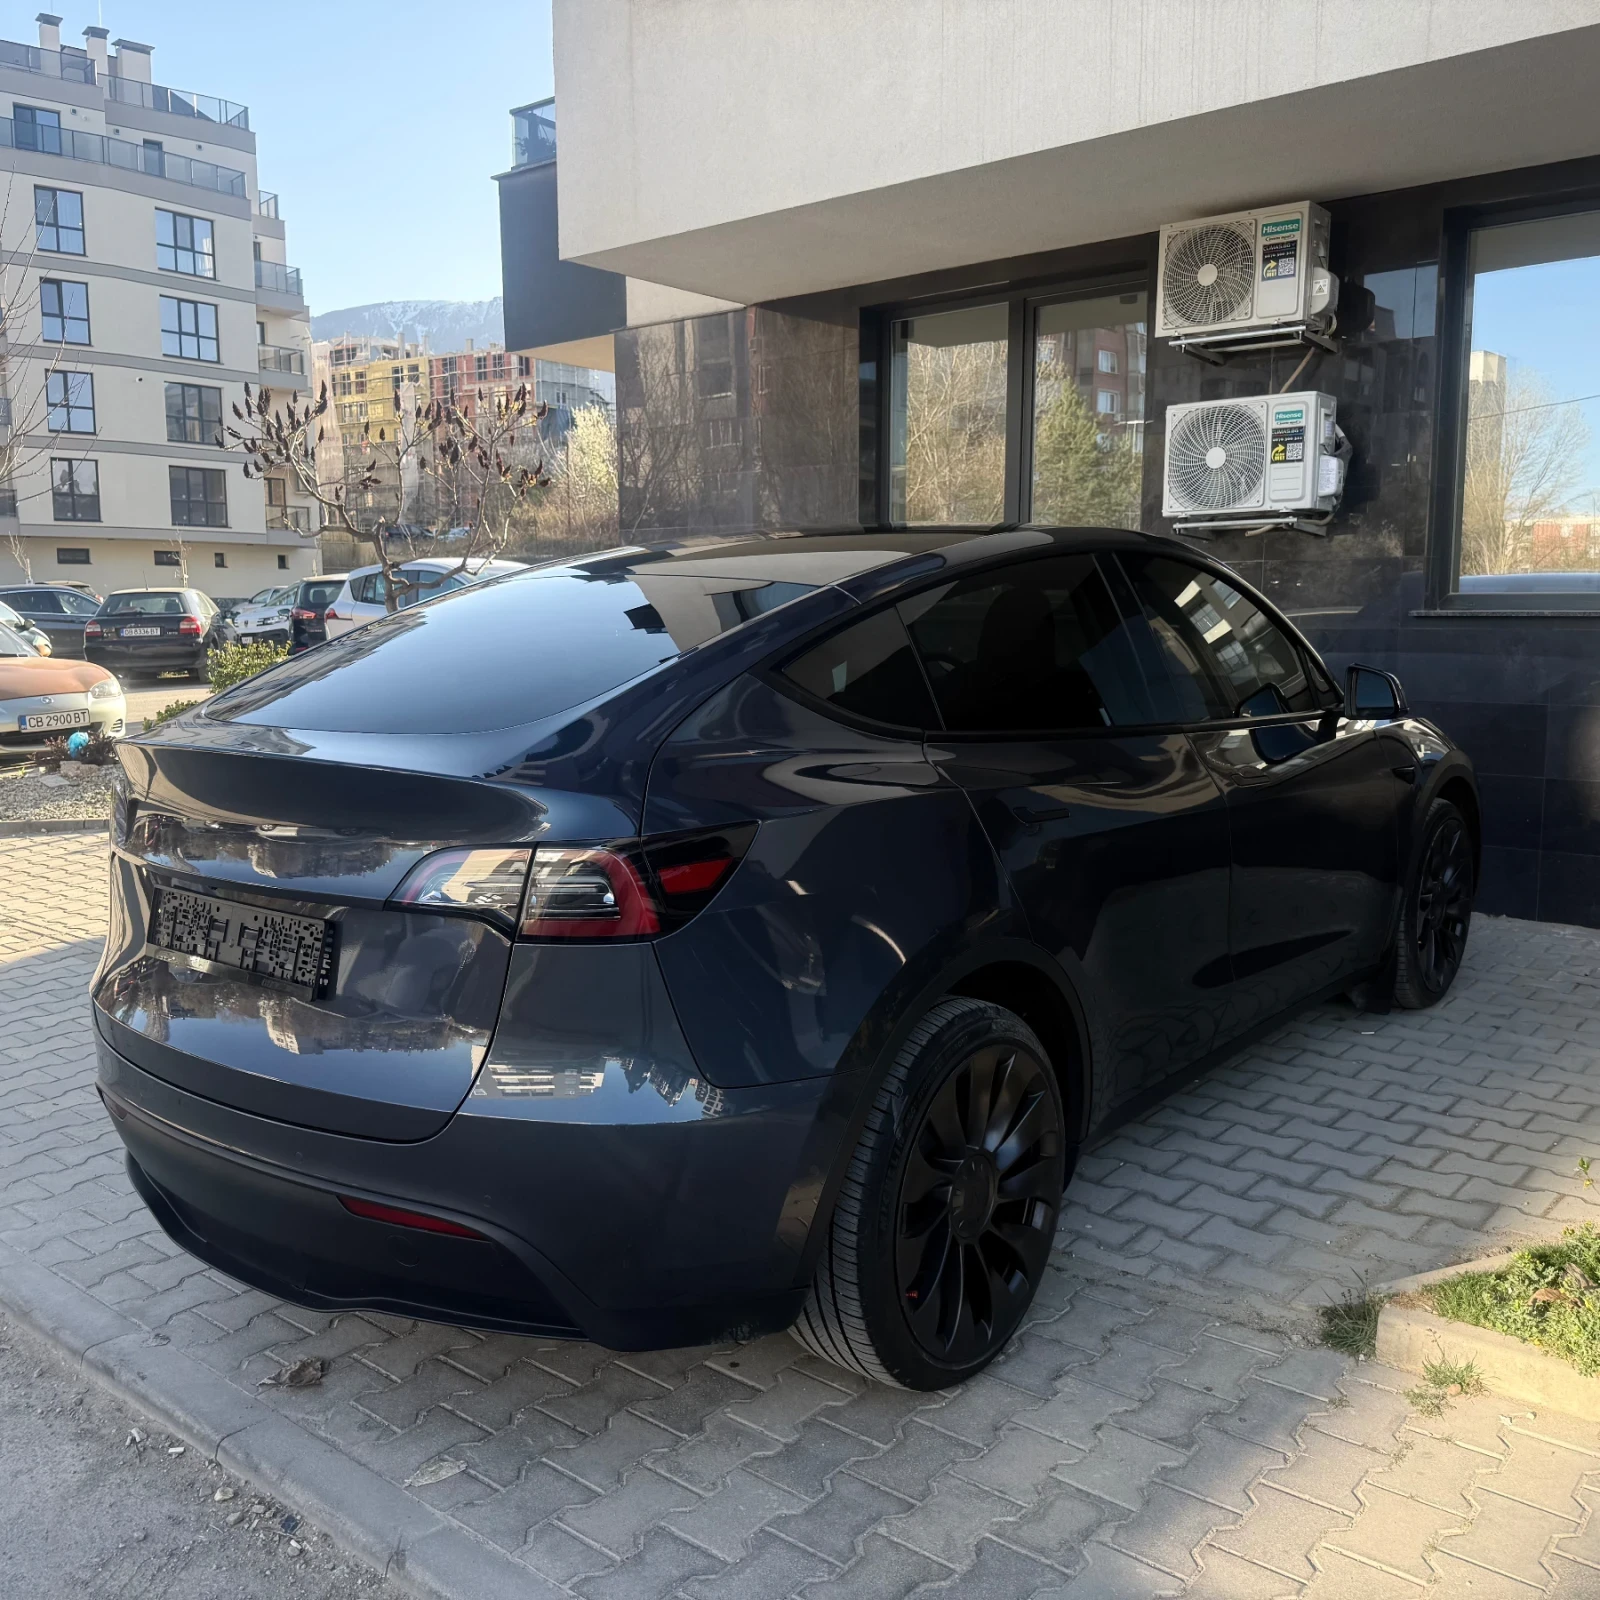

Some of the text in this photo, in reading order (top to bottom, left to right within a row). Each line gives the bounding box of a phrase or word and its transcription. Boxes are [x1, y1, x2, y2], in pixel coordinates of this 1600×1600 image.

[1262, 223, 1299, 234] Hisense
[28, 716, 44, 728] CB
[46, 713, 72, 727] 2900
[74, 711, 87, 723] BT
